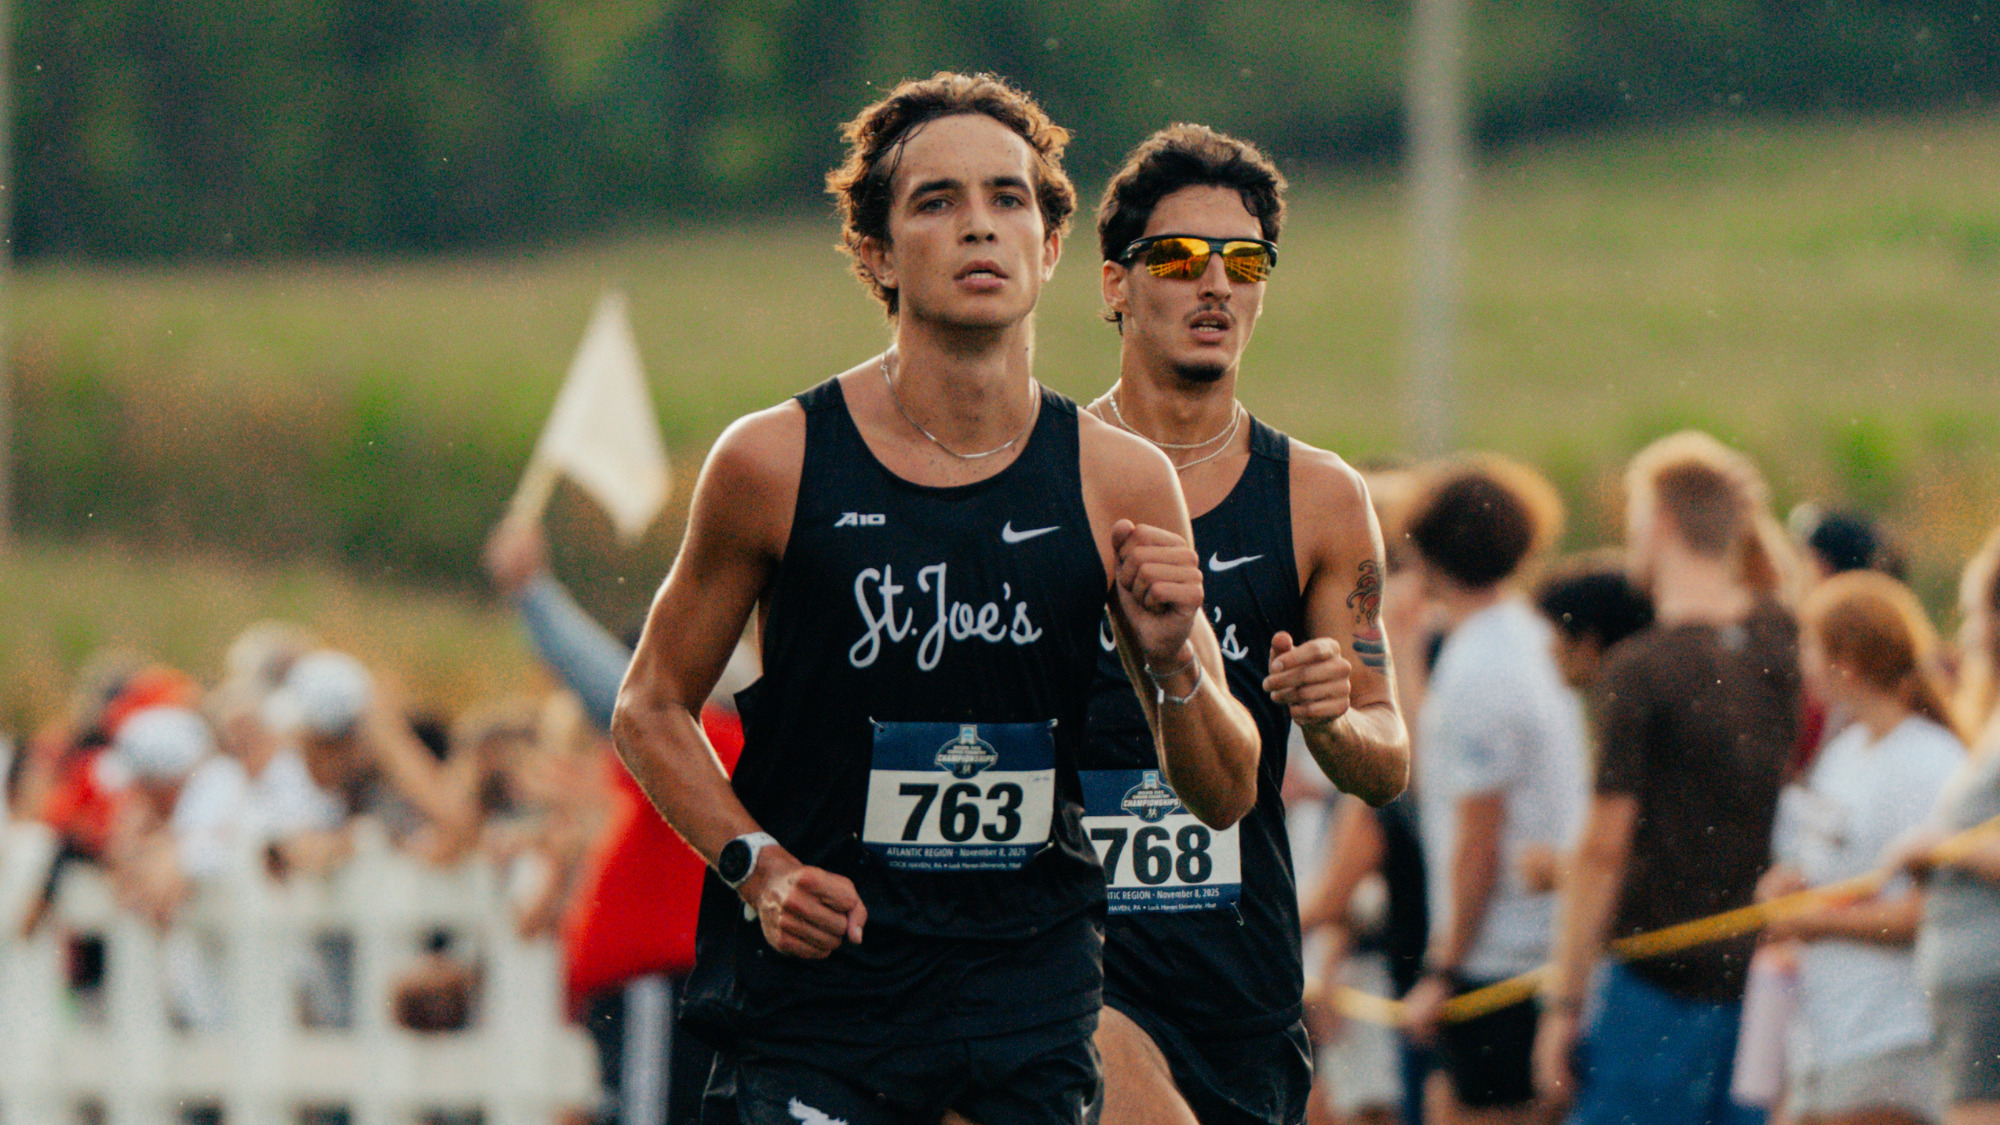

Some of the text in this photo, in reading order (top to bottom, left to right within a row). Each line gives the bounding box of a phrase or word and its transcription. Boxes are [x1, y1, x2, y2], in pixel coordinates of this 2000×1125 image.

[834, 511, 886, 527] A10
[1123, 798, 1179, 807] CHAMPIONSHIPS
[898, 782, 1024, 843] 763
[886, 847, 922, 857] ATLANTIC
[924, 848, 954, 857] REGION
[959, 847, 997, 857] November
[1008, 847, 1027, 856] 2025
[1090, 824, 1213, 885] 768
[1122, 890, 1151, 900] REGION
[1157, 889, 1193, 899] November
[1194, 888, 1201, 898] 8,
[1202, 888, 1220, 897] 2025
[1108, 904, 1132, 912] HAVEN,
